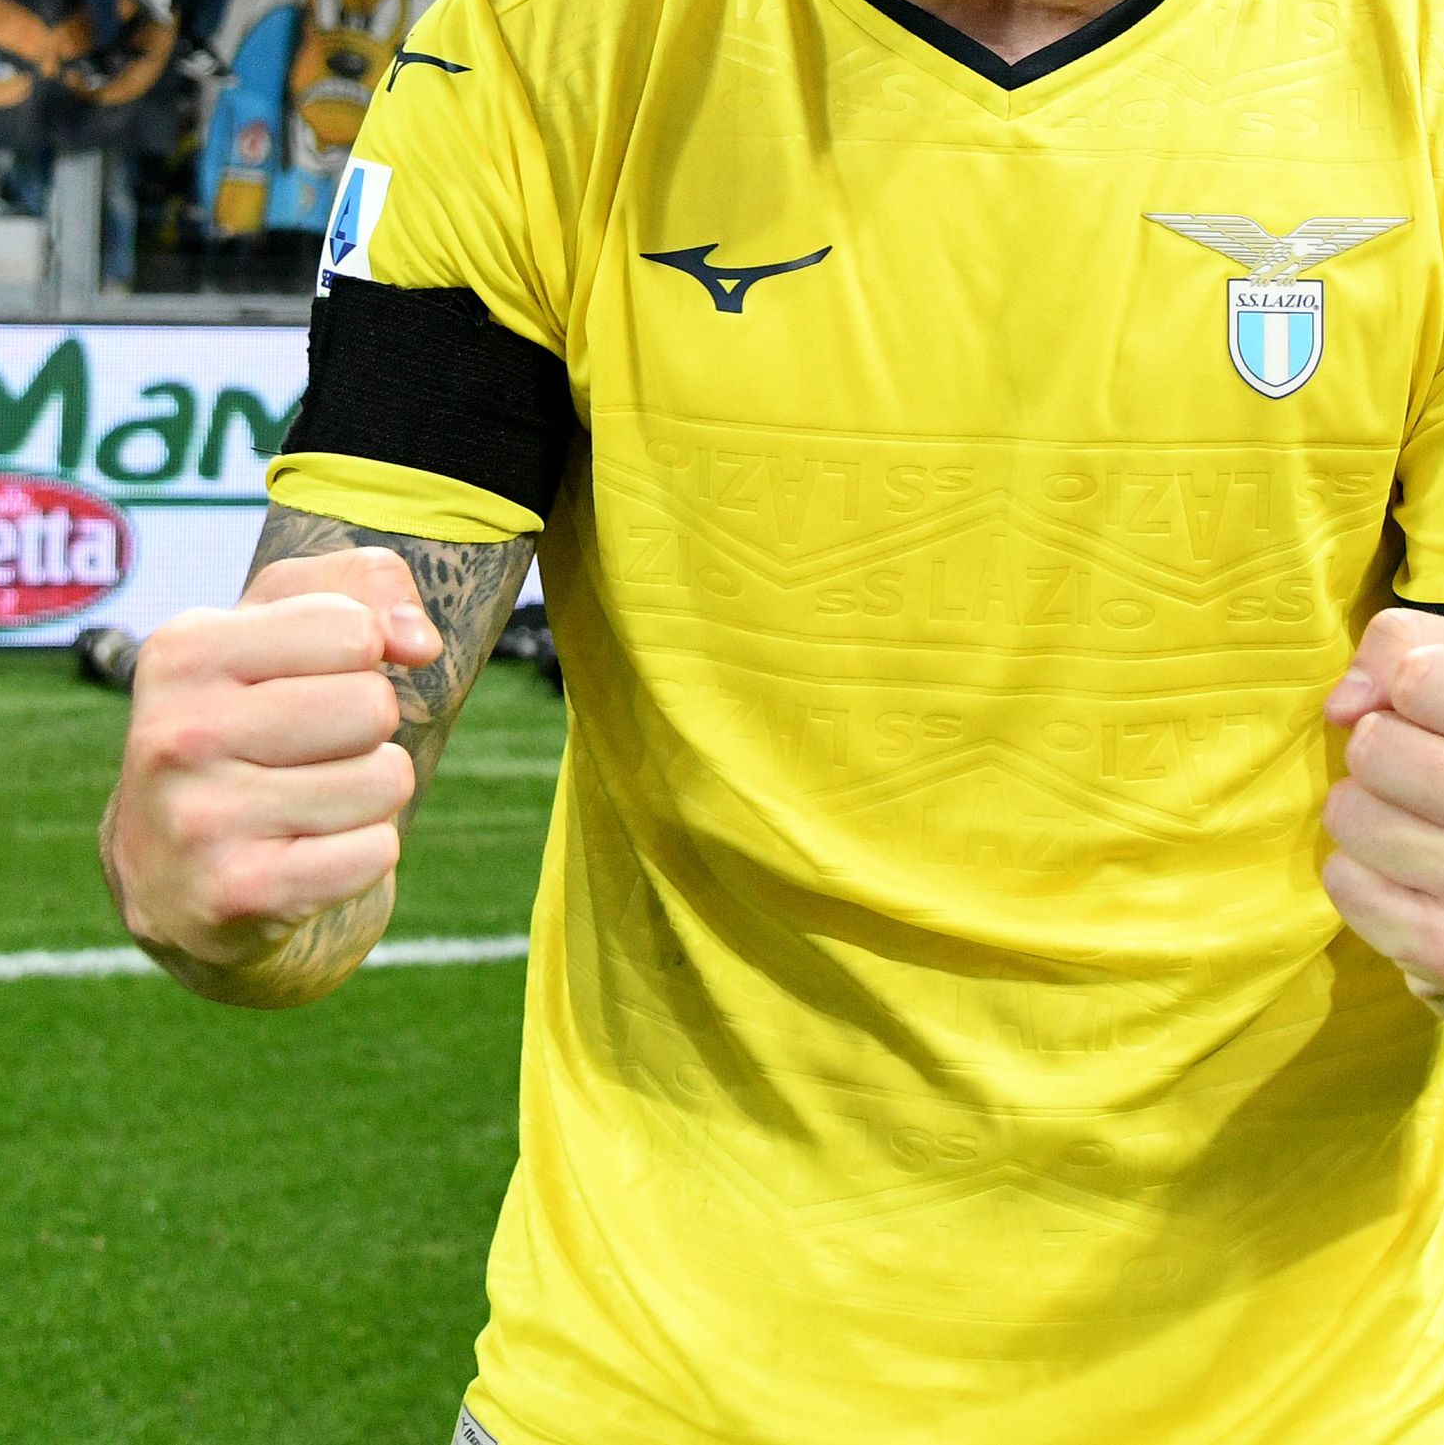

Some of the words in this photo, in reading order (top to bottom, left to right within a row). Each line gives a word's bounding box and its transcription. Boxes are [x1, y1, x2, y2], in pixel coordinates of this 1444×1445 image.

[1040, 470, 1272, 561] LAZIO
[624, 525, 744, 599] ZIO
[927, 532, 1155, 631] LAZIO
